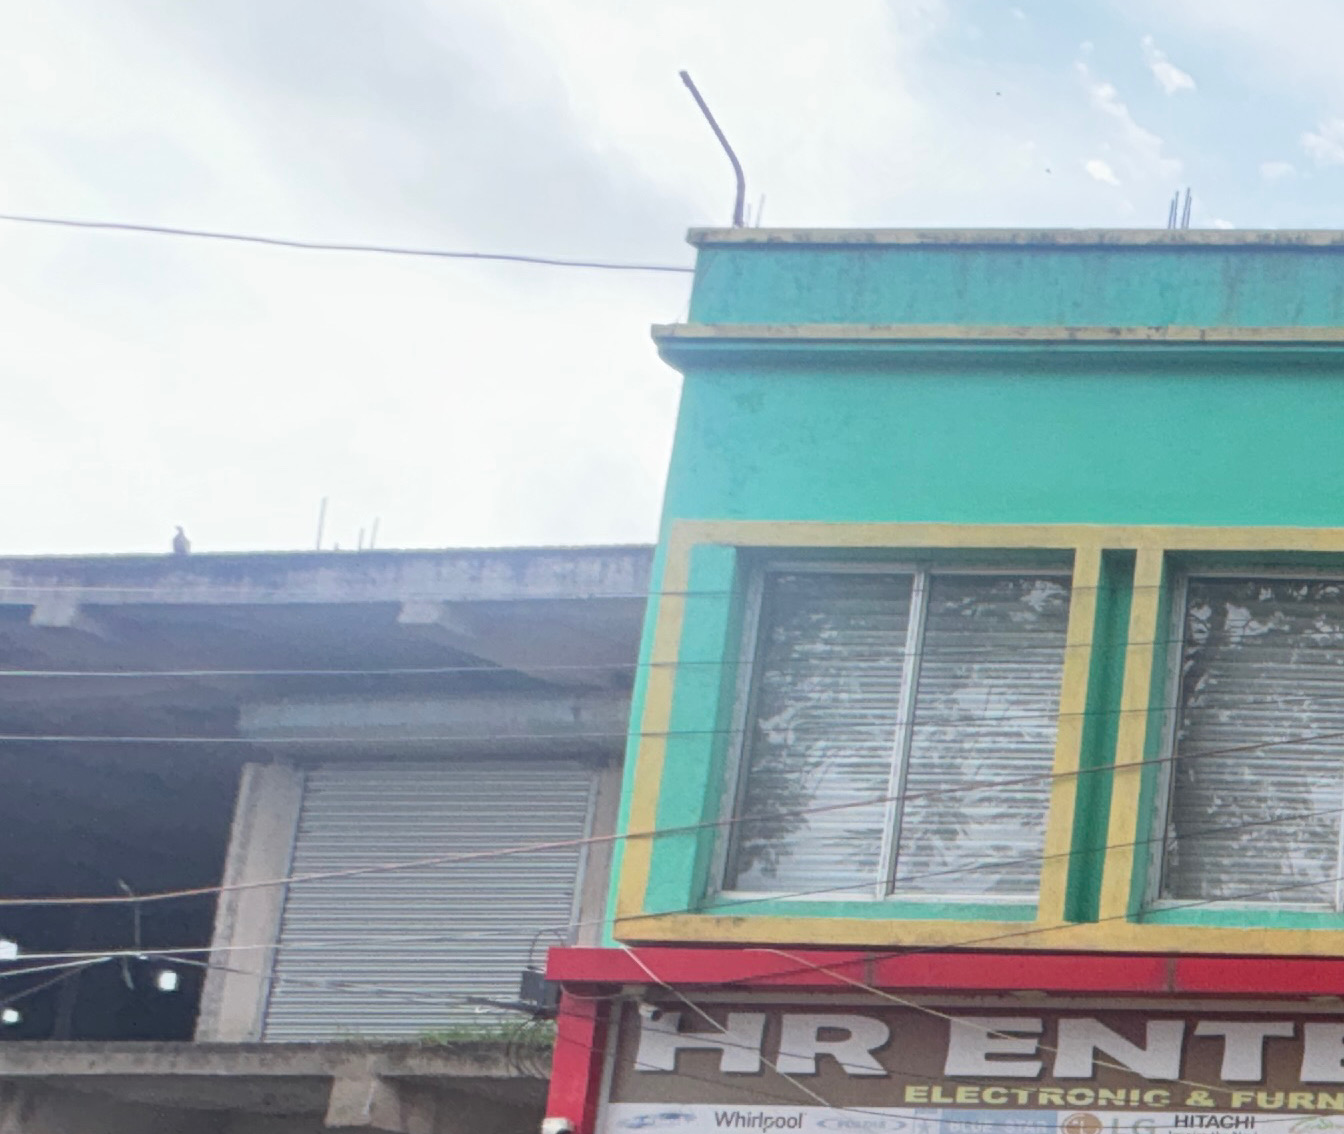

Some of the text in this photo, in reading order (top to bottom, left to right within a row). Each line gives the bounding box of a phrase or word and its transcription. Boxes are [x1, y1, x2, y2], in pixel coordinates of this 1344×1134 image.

[633, 1012, 890, 1077] HR
[905, 1085, 1170, 1110] ELECTRONIC
[1185, 1087, 1217, 1108] &
[714, 1111, 803, 1133] Whirlpool
[1174, 1114, 1256, 1130] HITACHI
